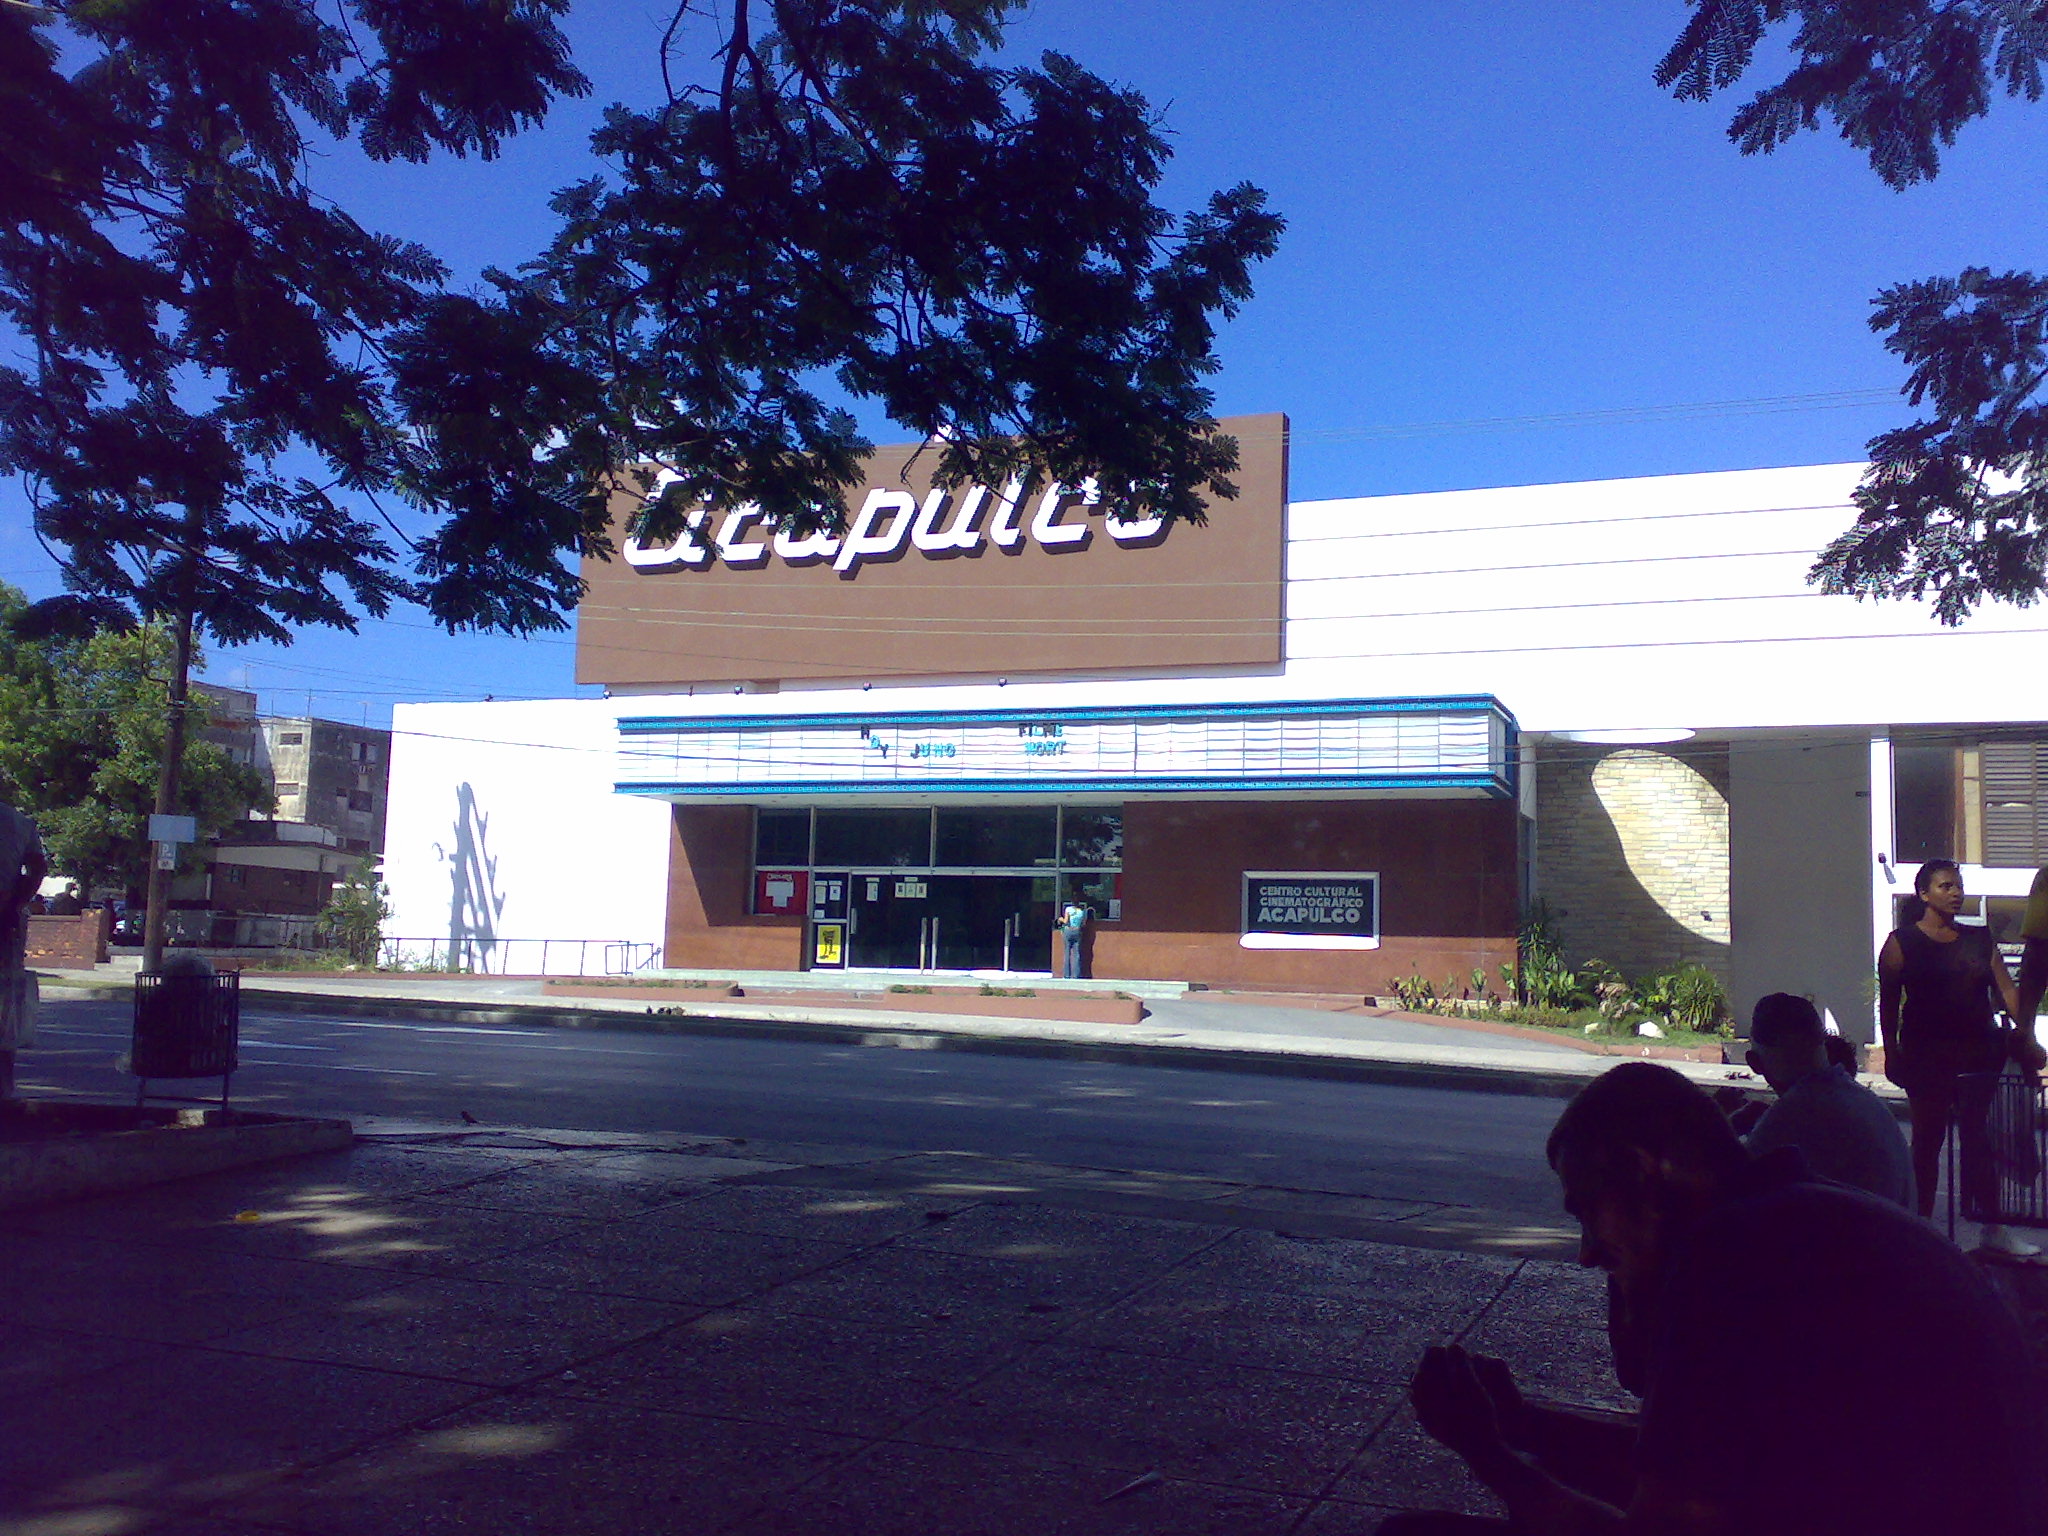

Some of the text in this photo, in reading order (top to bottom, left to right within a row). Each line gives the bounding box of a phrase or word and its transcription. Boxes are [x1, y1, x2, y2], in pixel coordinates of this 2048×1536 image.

[1259, 886, 1363, 897] CENTRO CULTURAL
[1257, 907, 1361, 923] ACAPULCO
